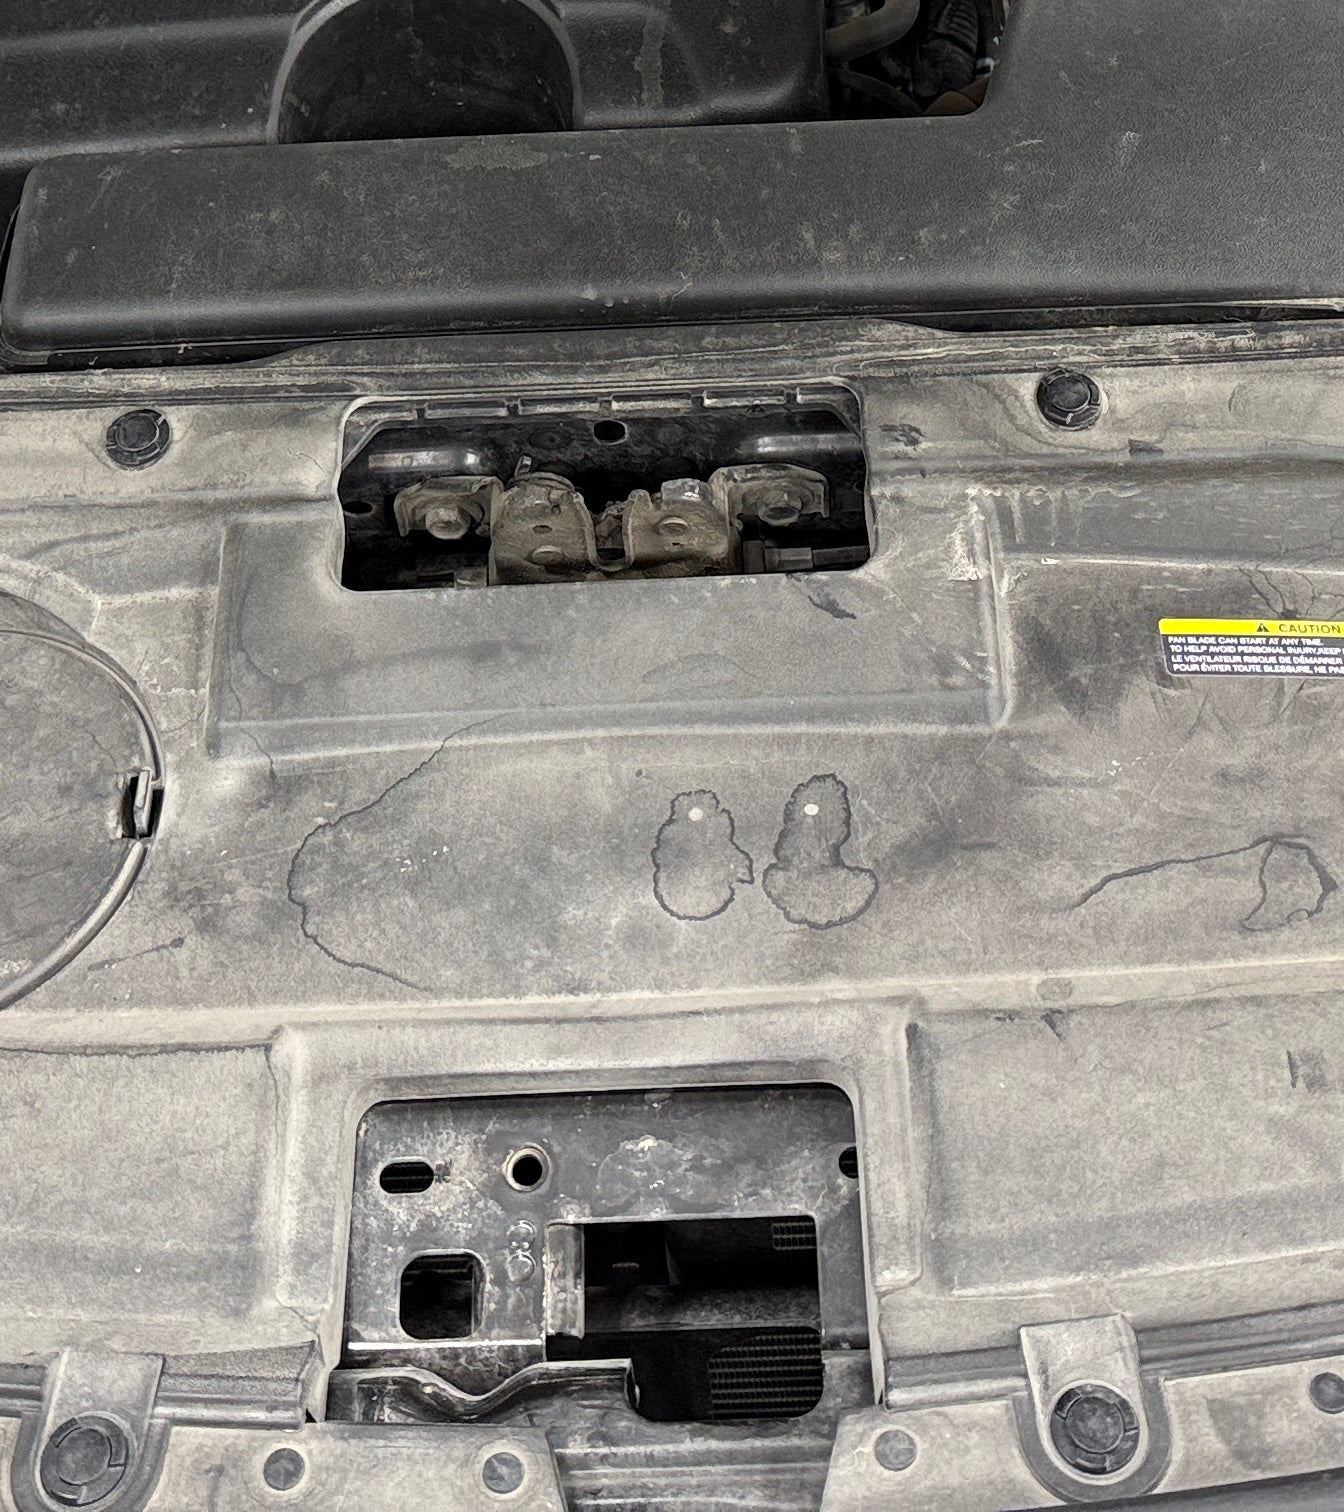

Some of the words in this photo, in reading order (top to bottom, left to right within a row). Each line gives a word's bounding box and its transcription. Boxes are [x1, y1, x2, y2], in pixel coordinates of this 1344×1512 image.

[1279, 624, 1341, 634] CAUTION
[1281, 638, 1299, 646] ANY
[1184, 645, 1207, 653] HELP
[1174, 664, 1200, 672] POUR
[1233, 665, 1263, 673] TOUTE
